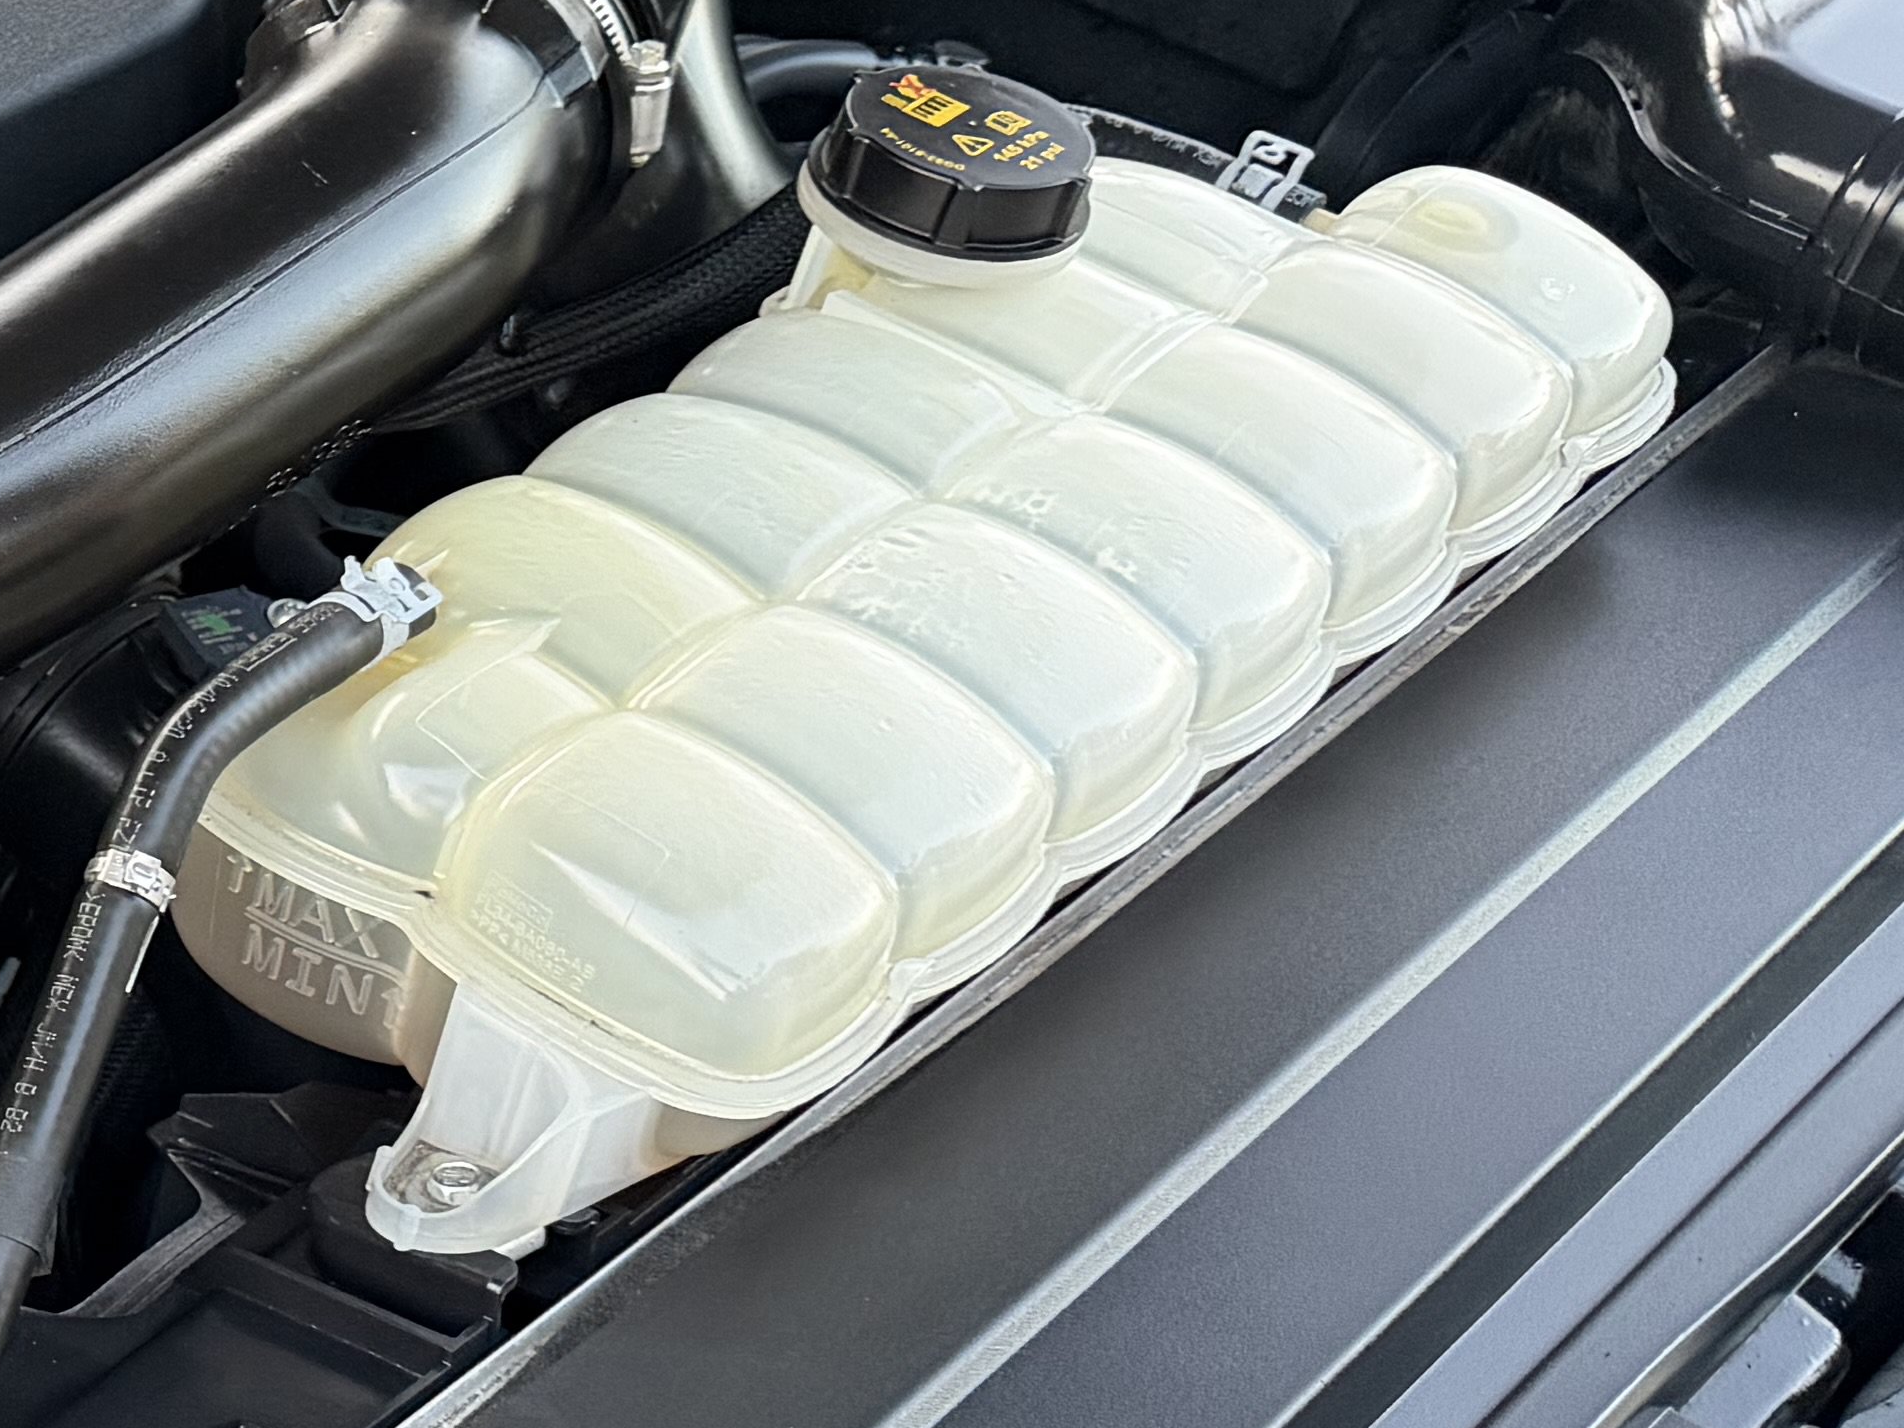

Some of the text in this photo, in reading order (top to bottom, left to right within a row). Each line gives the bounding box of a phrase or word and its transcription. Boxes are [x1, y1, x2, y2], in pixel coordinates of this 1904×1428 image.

[1019, 155, 1044, 171] 21
[253, 873, 383, 959] MAX
[241, 924, 374, 1015] MIN
